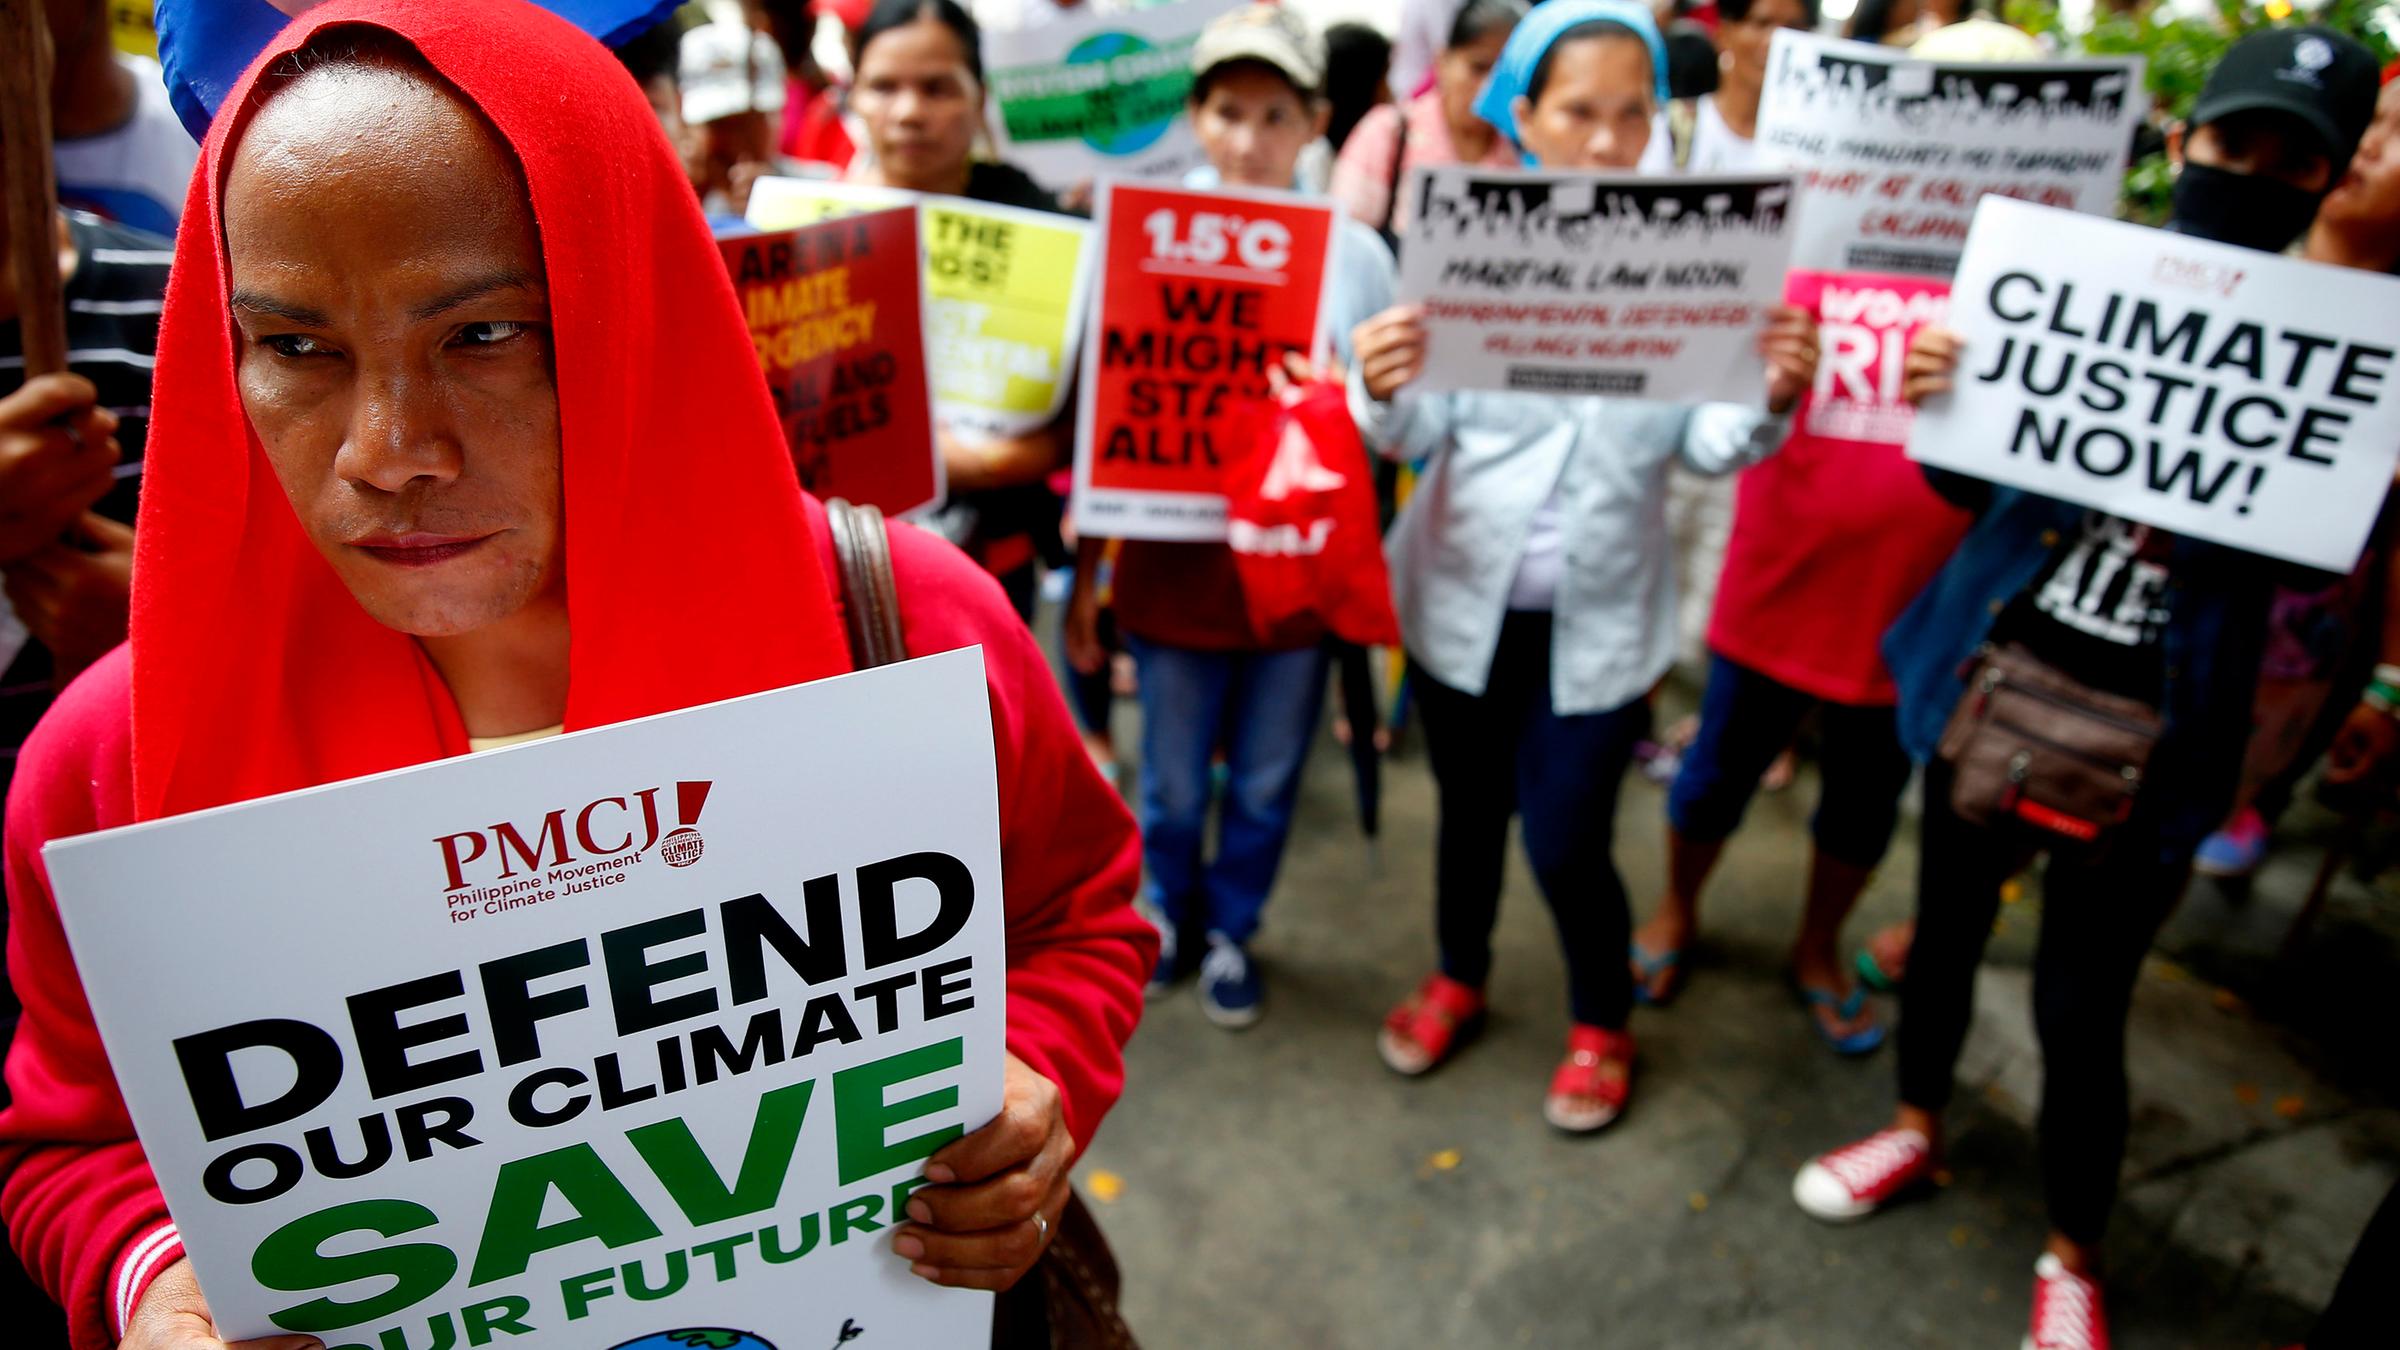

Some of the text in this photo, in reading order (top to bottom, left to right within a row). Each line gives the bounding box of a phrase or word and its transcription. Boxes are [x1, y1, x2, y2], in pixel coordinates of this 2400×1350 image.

[934, 211, 1014, 250] THE
[1143, 208, 1292, 271] 1.5°C
[1162, 282, 1264, 331] WE
[1820, 282, 1952, 329] WOM
[1813, 322, 1906, 407] RI
[1987, 271, 2395, 405] CLIMATE
[1128, 376, 1268, 419] STA
[1977, 338, 2352, 466] JUSTICE
[1104, 425, 1222, 469] ALIV
[2009, 407, 2267, 515] NOW!
[661, 839, 704, 857] CLIMATE
[447, 851, 642, 909] Philippine Movement
[450, 872, 626, 923] for Climate Justice
[173, 851, 976, 1142] DEFEND
[202, 956, 975, 1205] OUR CLIMATE
[251, 1036, 964, 1333] SAVE
[327, 1295, 538, 1350] UR
